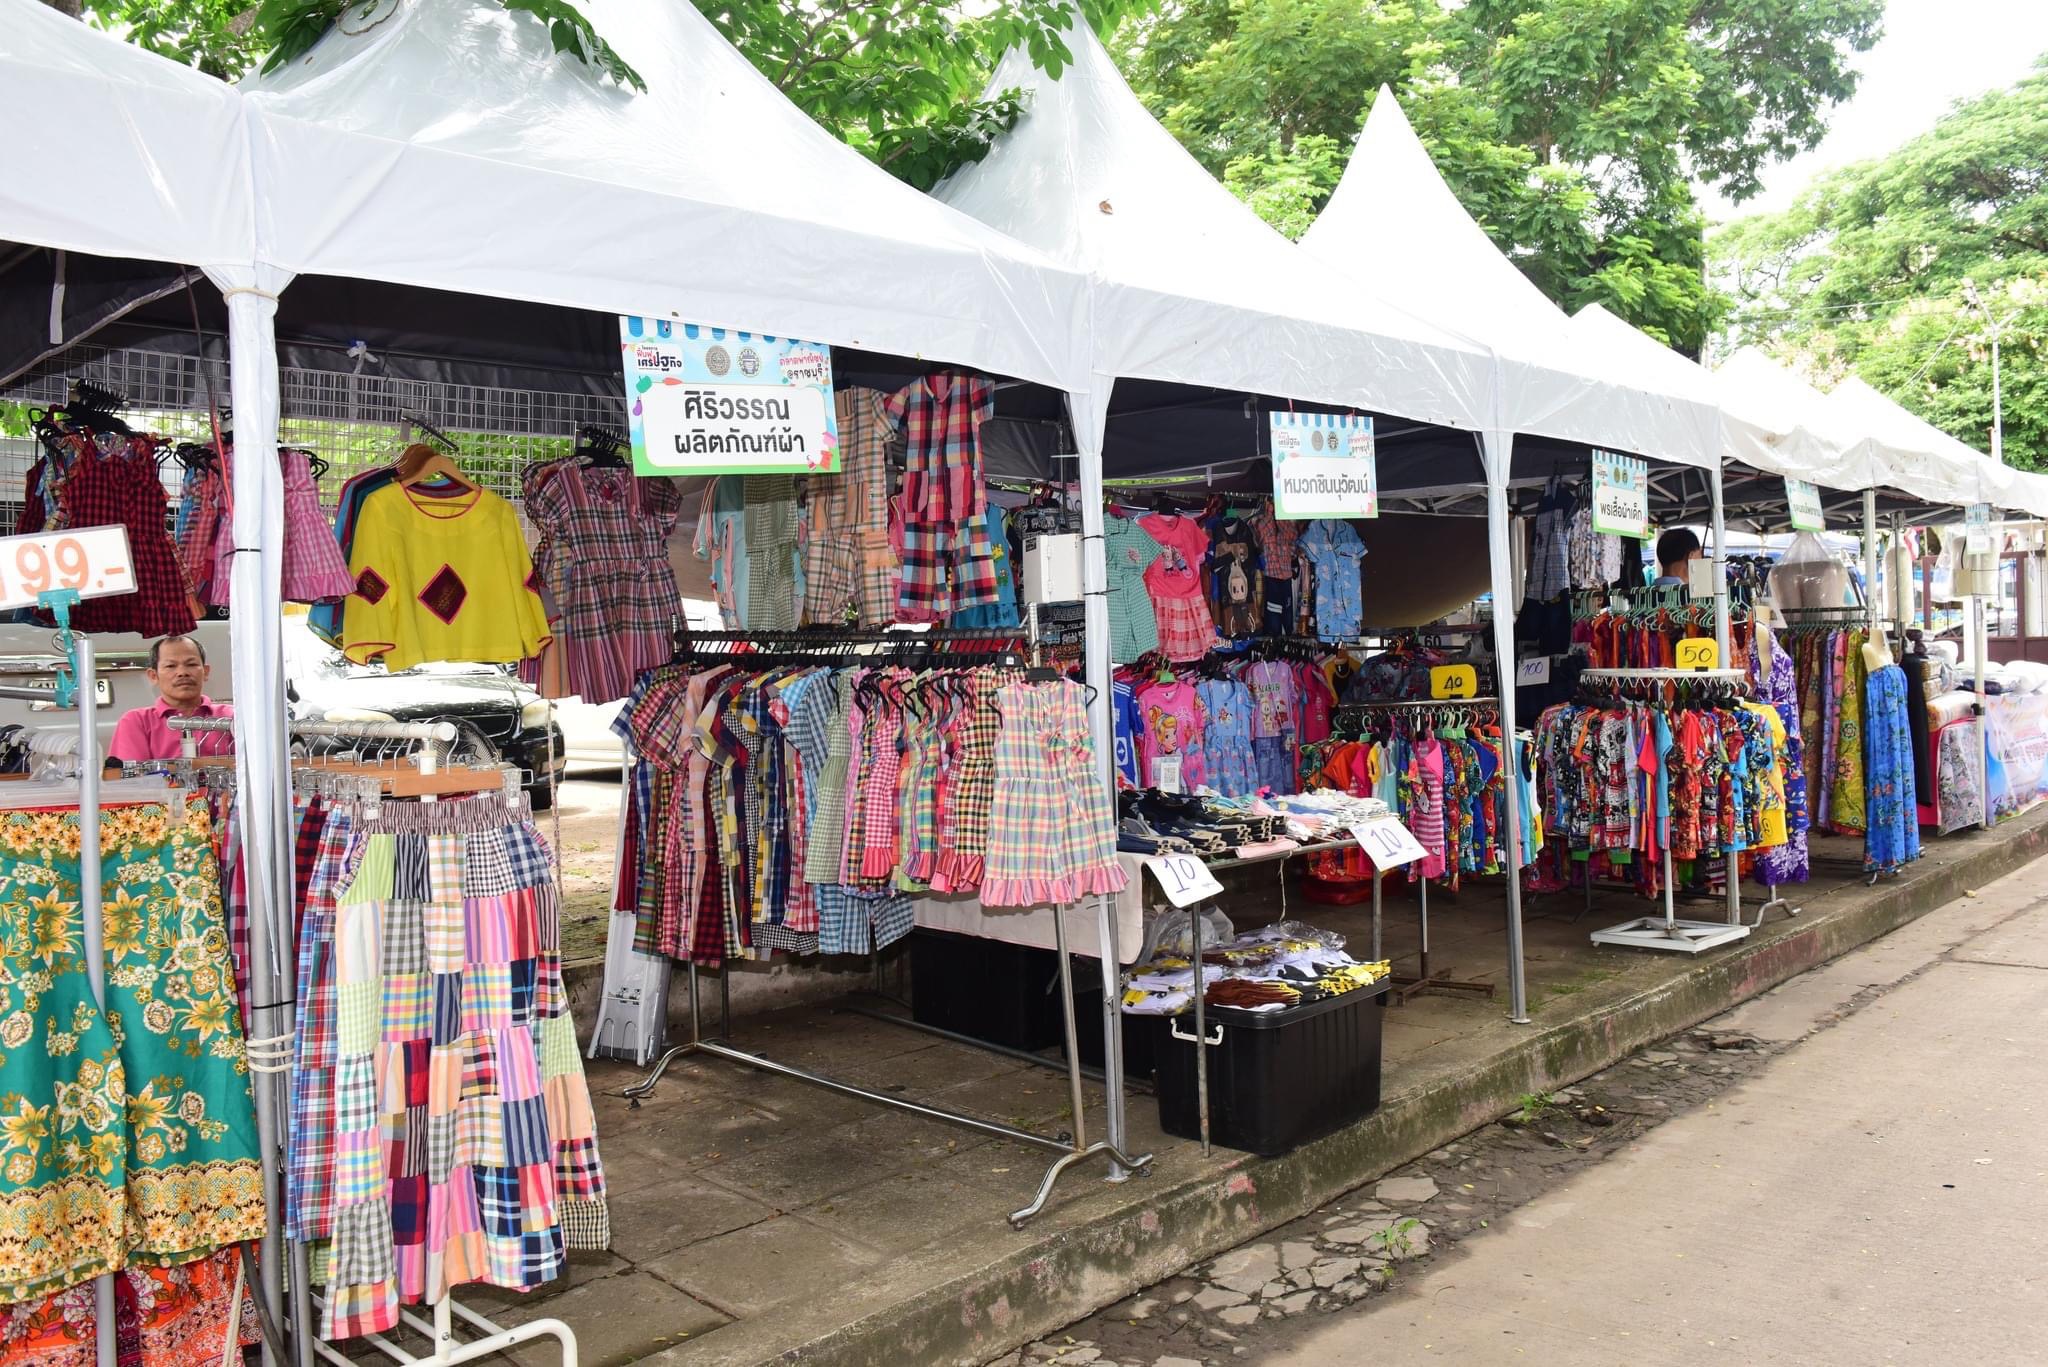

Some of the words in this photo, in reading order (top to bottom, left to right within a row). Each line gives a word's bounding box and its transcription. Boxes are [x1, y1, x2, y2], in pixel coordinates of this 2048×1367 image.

[684, 390, 790, 420] ศิริวรรณ
[674, 427, 805, 454] ผลิตภัณฑ์ผ้า
[1283, 473, 1369, 501] หมวกชินนุวัฒน์
[1424, 635, 1441, 647] 60
[1682, 646, 1713, 663] 50
[1523, 661, 1544, 677] 100
[1370, 827, 1403, 858] 10
[1163, 858, 1196, 894] 10
